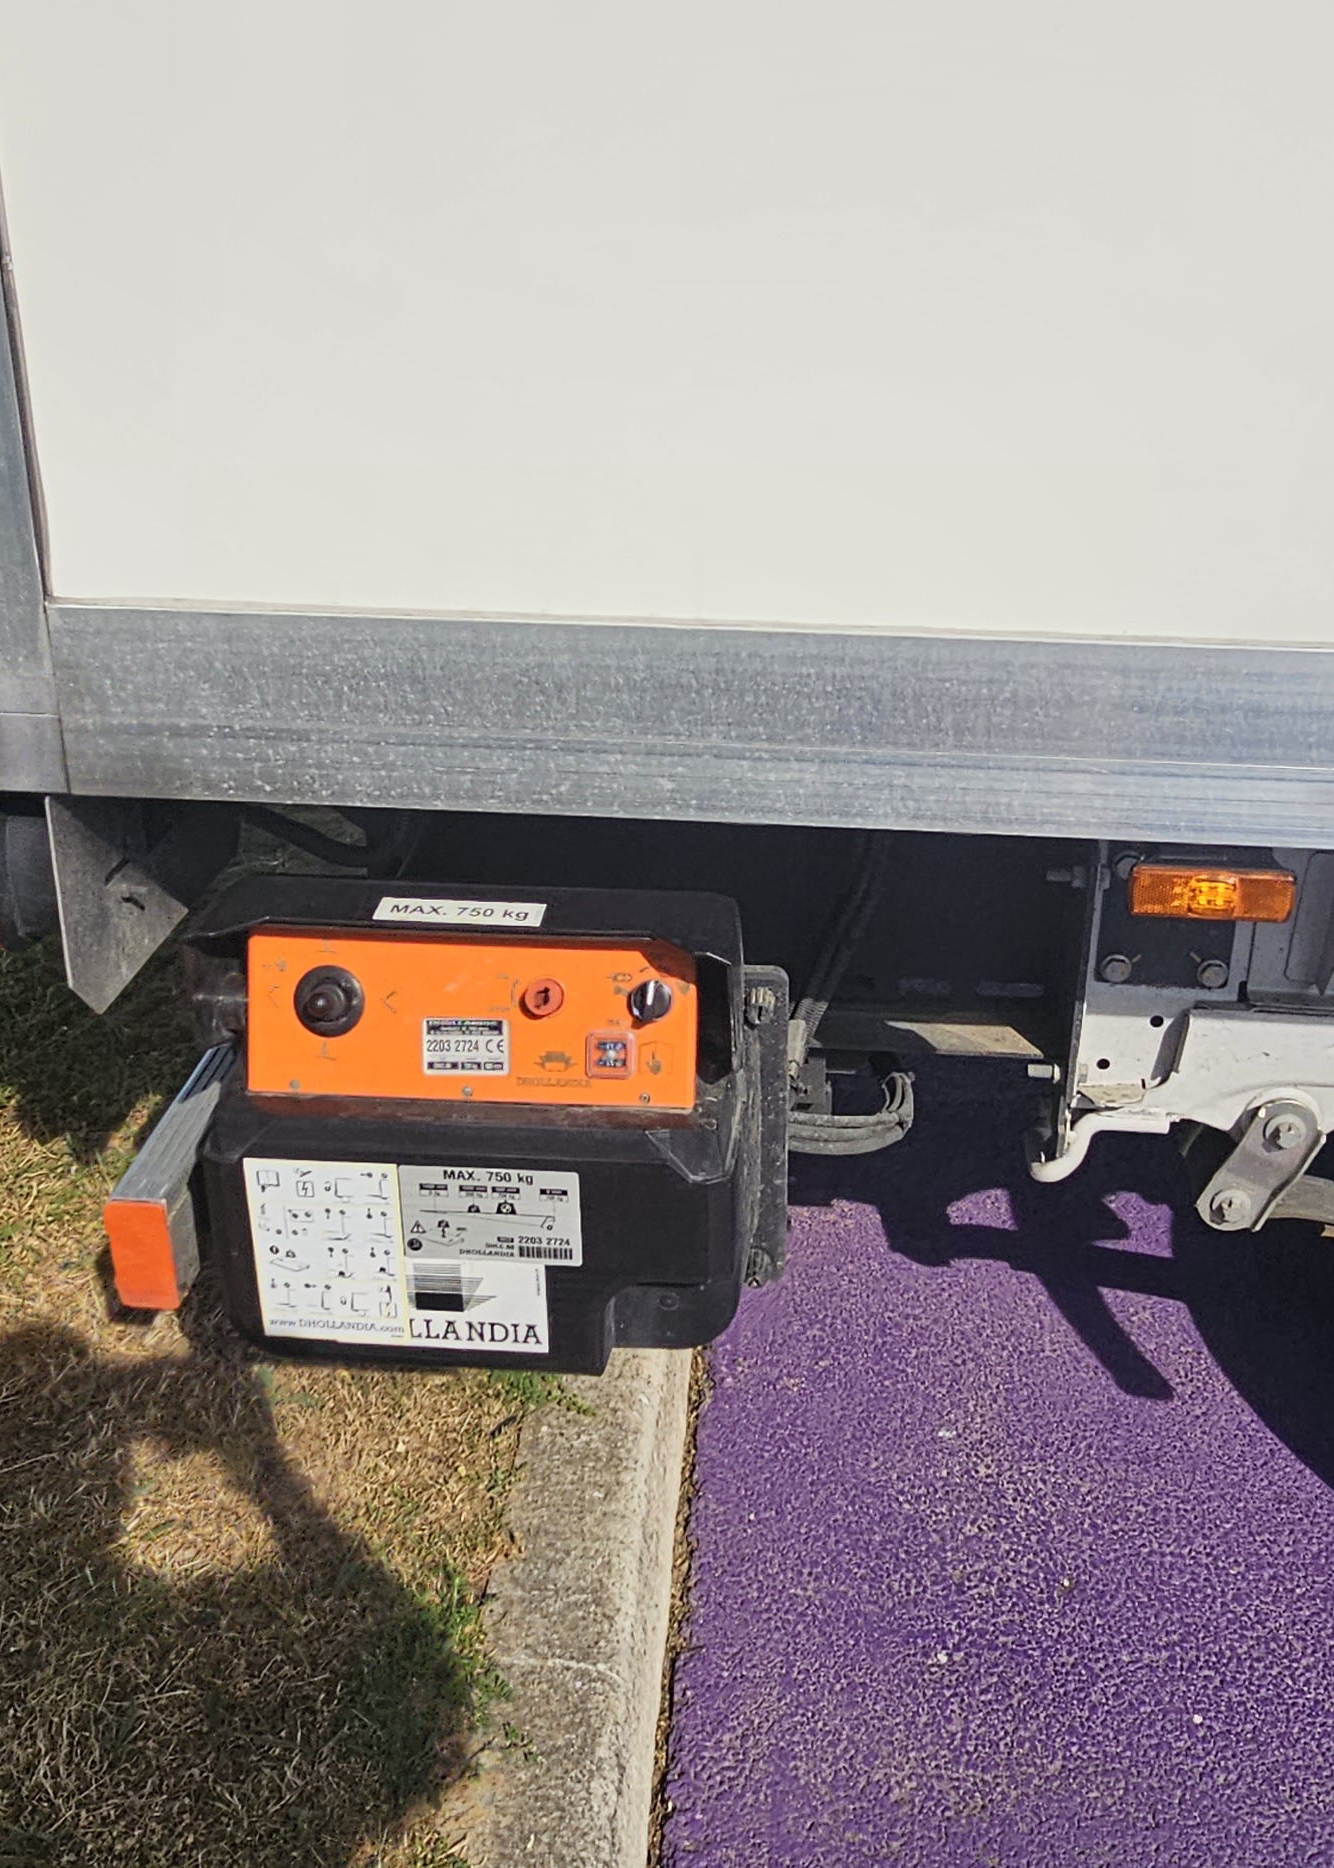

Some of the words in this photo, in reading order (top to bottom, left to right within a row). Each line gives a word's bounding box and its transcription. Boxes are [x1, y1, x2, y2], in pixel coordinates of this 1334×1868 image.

[390, 904, 447, 916] MAX.
[457, 907, 494, 917] 750
[502, 909, 529, 921] kg
[427, 1039, 451, 1052] 2203
[455, 1040, 479, 1052] 2724
[443, 1169, 481, 1182] MAX.
[486, 1171, 512, 1183] 750
[517, 1173, 534, 1185] kg
[518, 1235, 542, 1245] 2203
[546, 1237, 571, 1246] 2724
[459, 1248, 515, 1258] DHOLLANDIA
[268, 1319, 405, 1334] www.DHOLLANDIA.com
